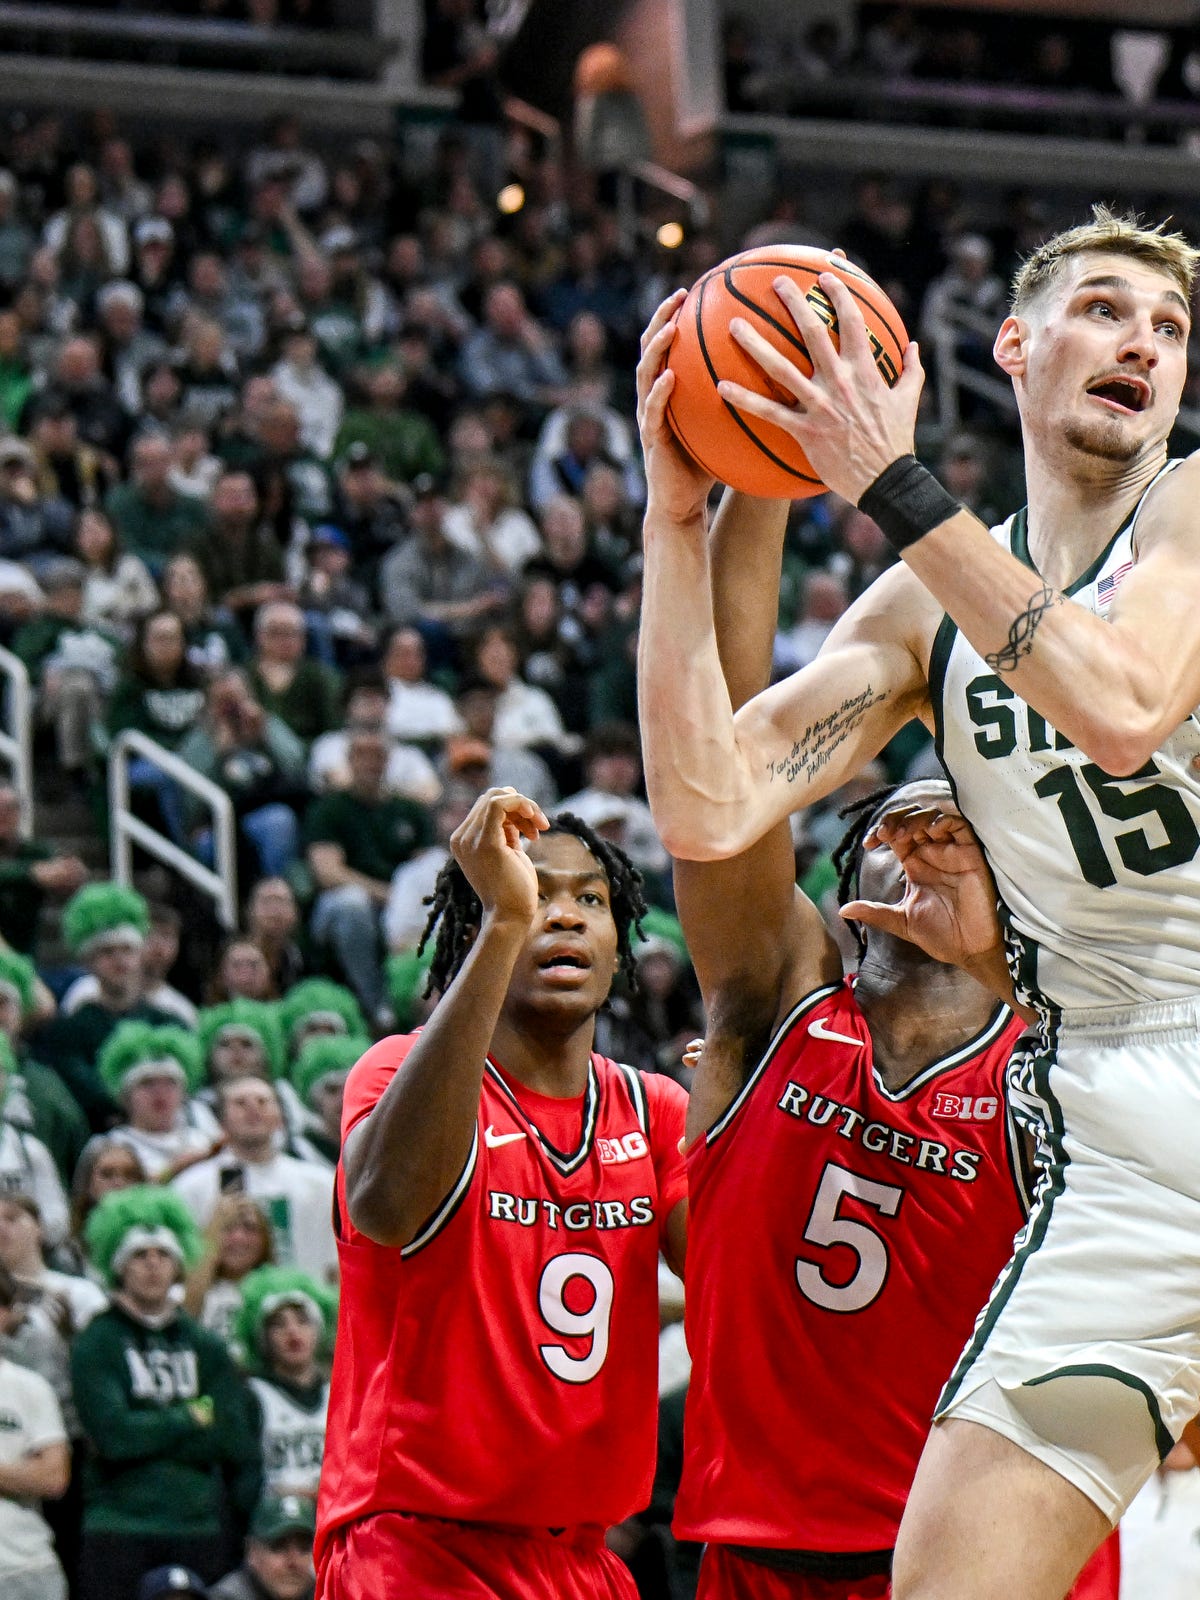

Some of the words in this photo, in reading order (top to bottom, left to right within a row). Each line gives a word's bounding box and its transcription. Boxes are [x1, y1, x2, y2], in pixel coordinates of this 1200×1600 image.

[778, 1081, 983, 1183] RUTGERS
[795, 1161, 904, 1315] 5
[537, 1252, 616, 1385] 9
